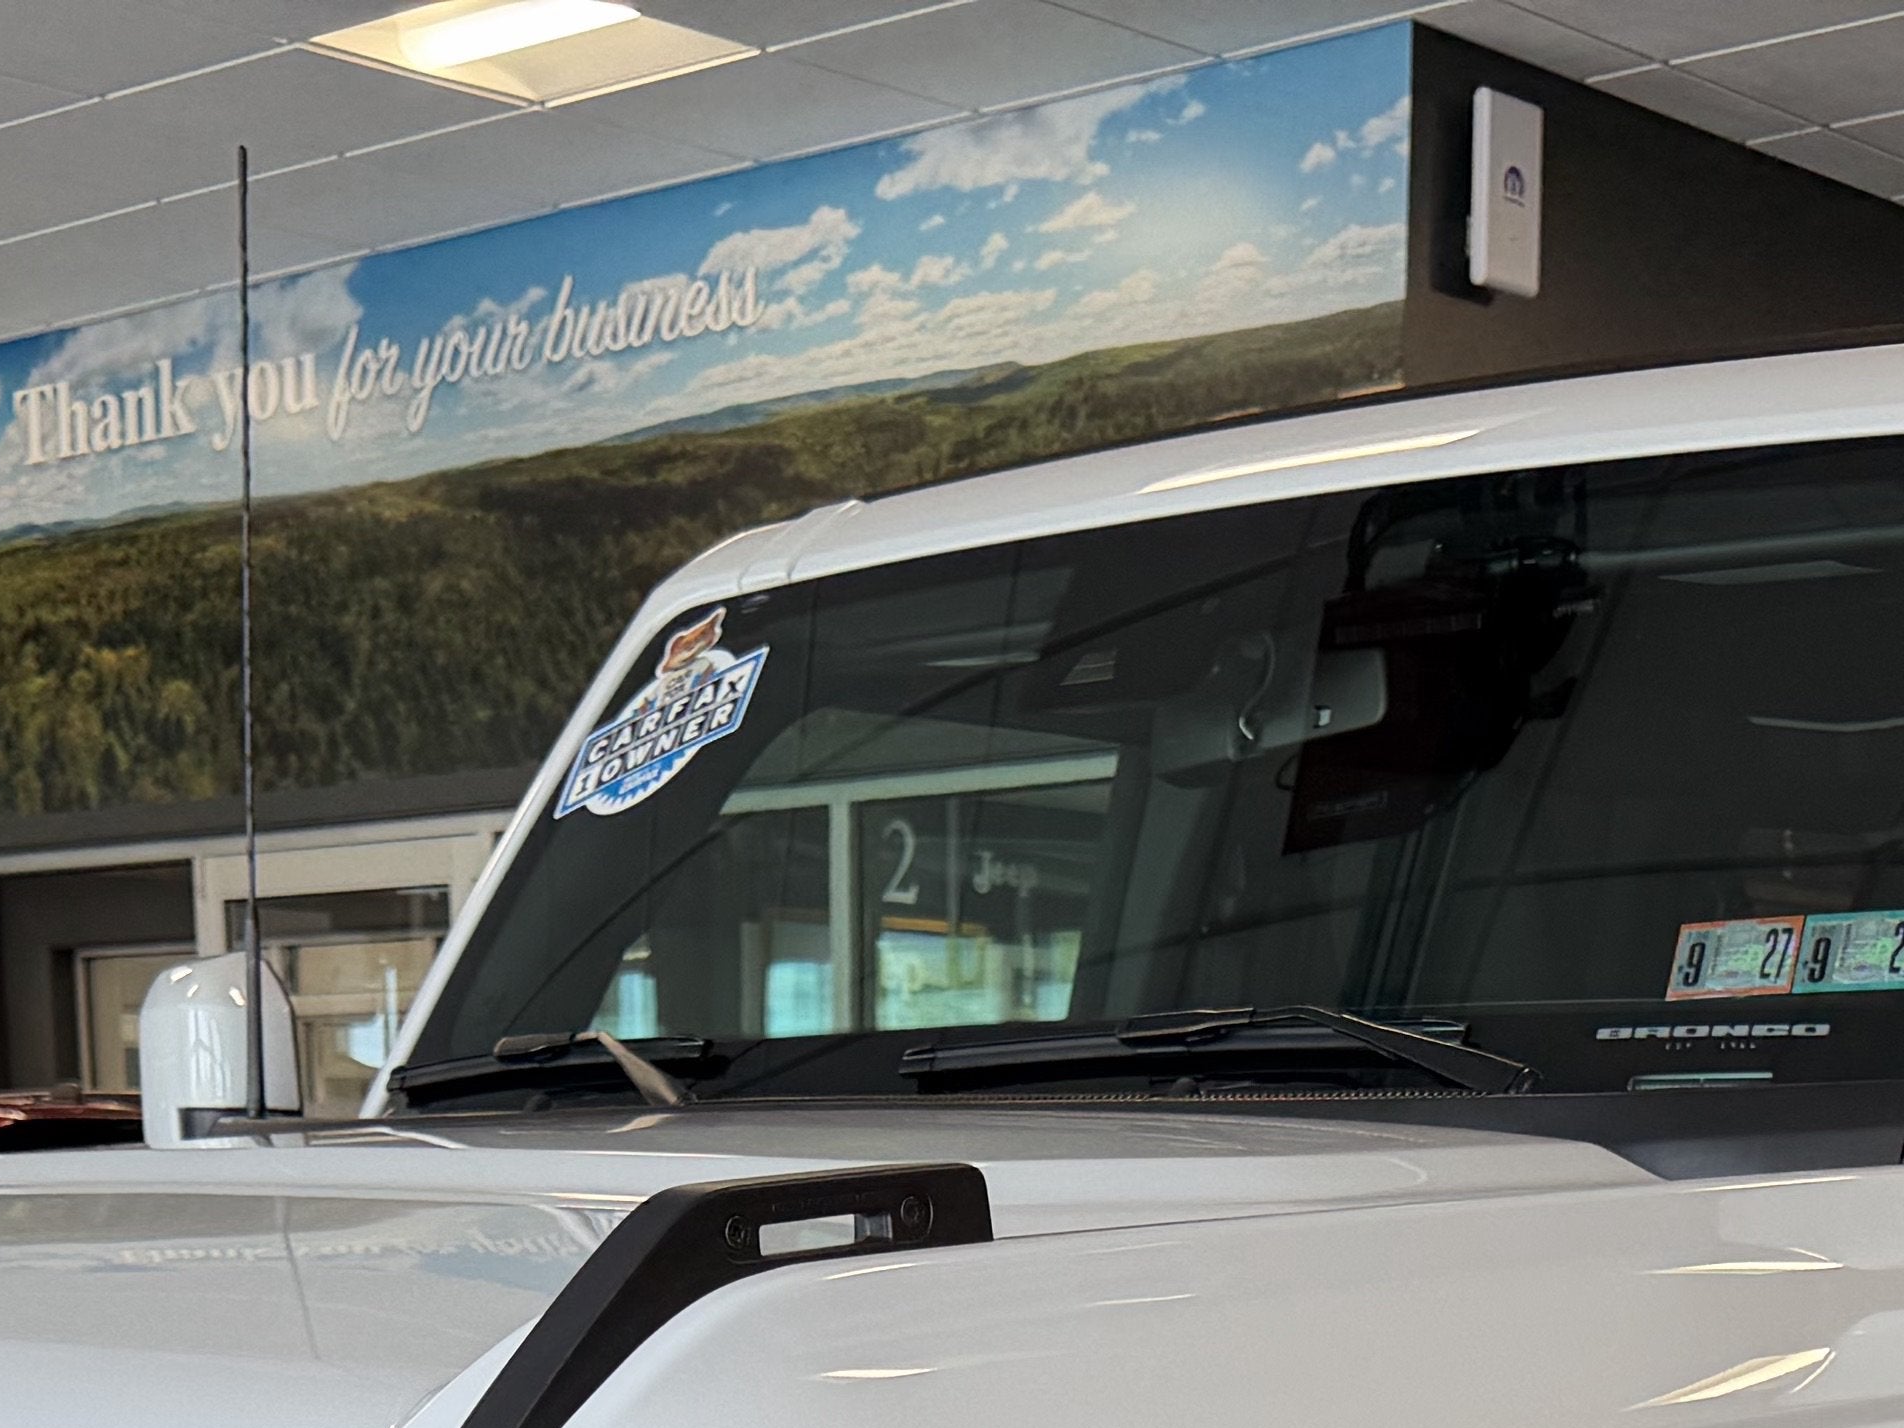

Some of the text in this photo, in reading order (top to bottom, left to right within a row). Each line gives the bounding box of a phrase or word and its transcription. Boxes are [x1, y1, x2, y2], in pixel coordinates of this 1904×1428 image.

[12, 267, 766, 466] Thank you for your business
[587, 674, 746, 765] CARFAX
[600, 702, 736, 783] OWNER
[1682, 927, 1794, 988] 9 27
[1807, 936, 1832, 984] 9
[1595, 1023, 1831, 1040] BRONCO
